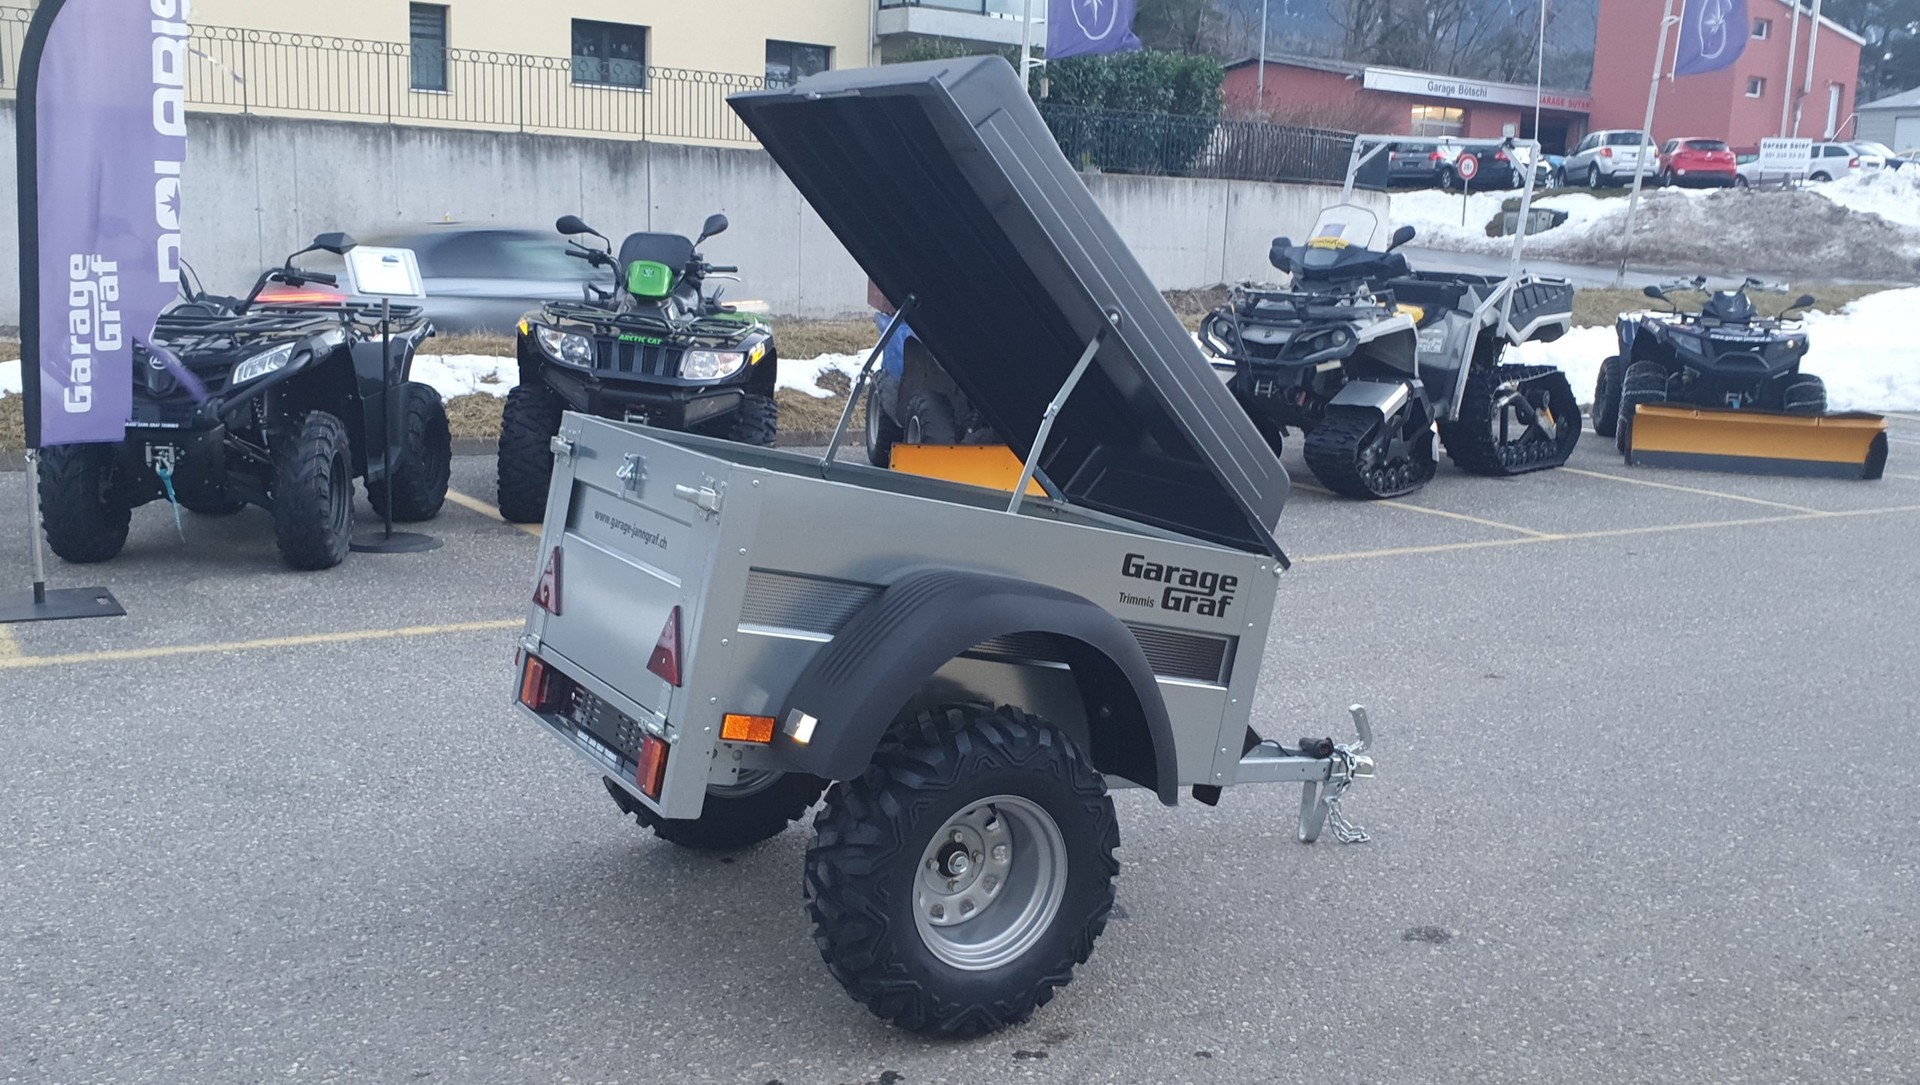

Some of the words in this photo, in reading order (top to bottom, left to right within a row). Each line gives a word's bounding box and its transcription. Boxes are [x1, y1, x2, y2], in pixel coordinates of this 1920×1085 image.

[1427, 80, 1456, 95] Garage
[1458, 81, 1488, 98] Bötschi
[1540, 95, 1565, 107] ARAGE
[91, 254, 122, 351] Graf
[64, 254, 98, 413] Garage
[618, 334, 646, 343] ARCTIC
[647, 337, 662, 345] CAT
[594, 509, 668, 551] www.garage-janngraf.ch
[1121, 552, 1239, 598] Garage
[1119, 591, 1155, 609] Trimmis
[1161, 586, 1234, 618] Graf
